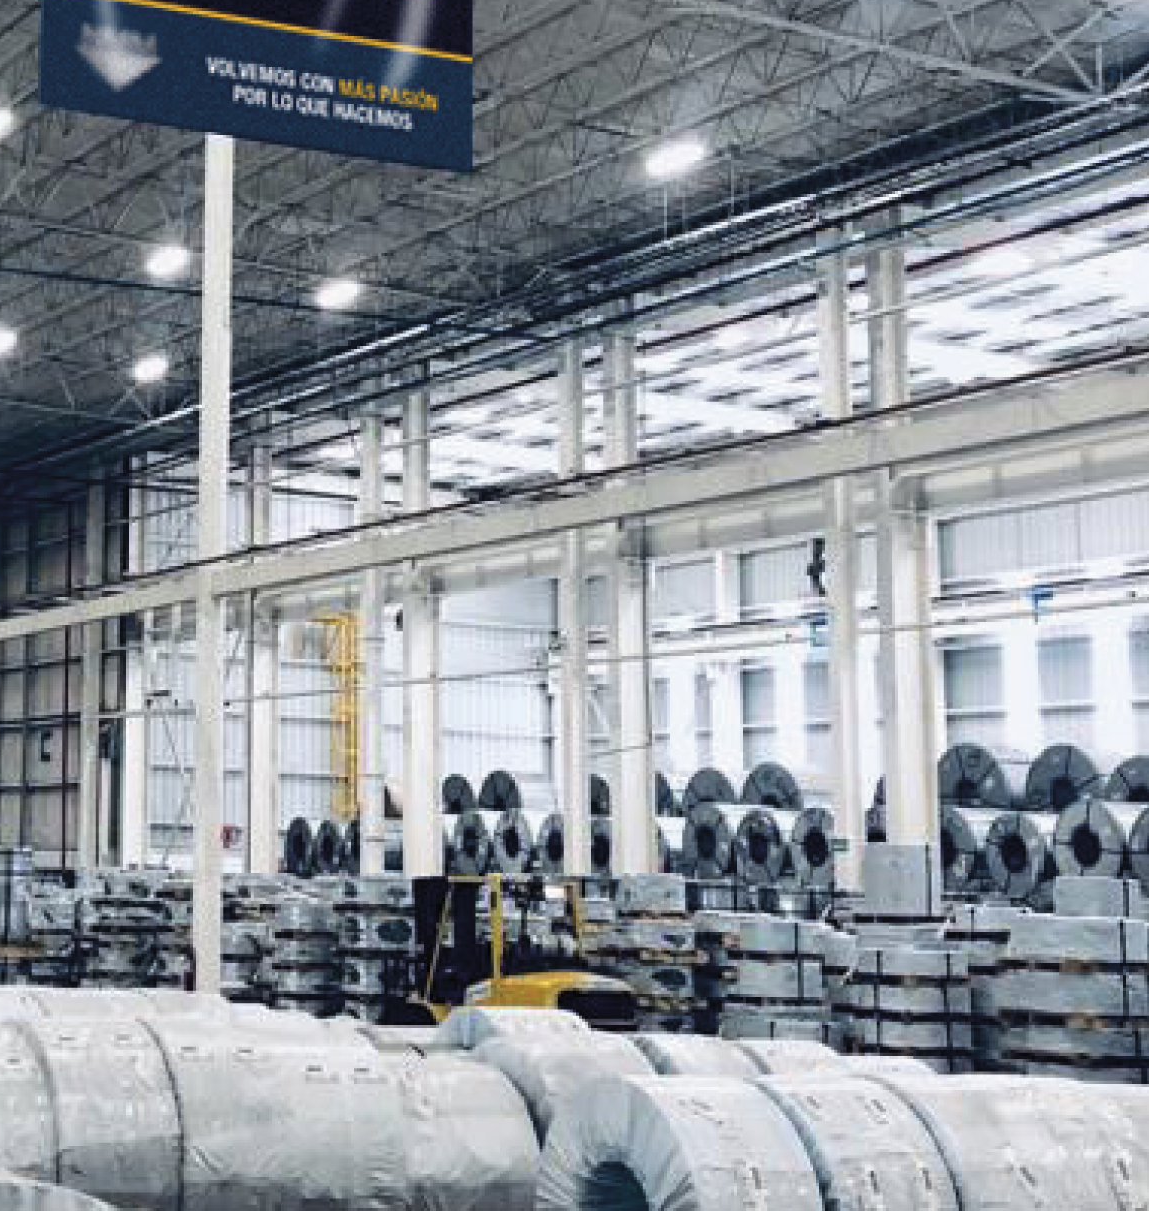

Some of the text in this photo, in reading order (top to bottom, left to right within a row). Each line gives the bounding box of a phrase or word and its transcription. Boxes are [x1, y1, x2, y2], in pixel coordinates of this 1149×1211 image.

[205, 56, 439, 112] VOLVEMOS CON MÁS PASIÓN
[232, 84, 414, 132] POR LO QUE HACEMOS
